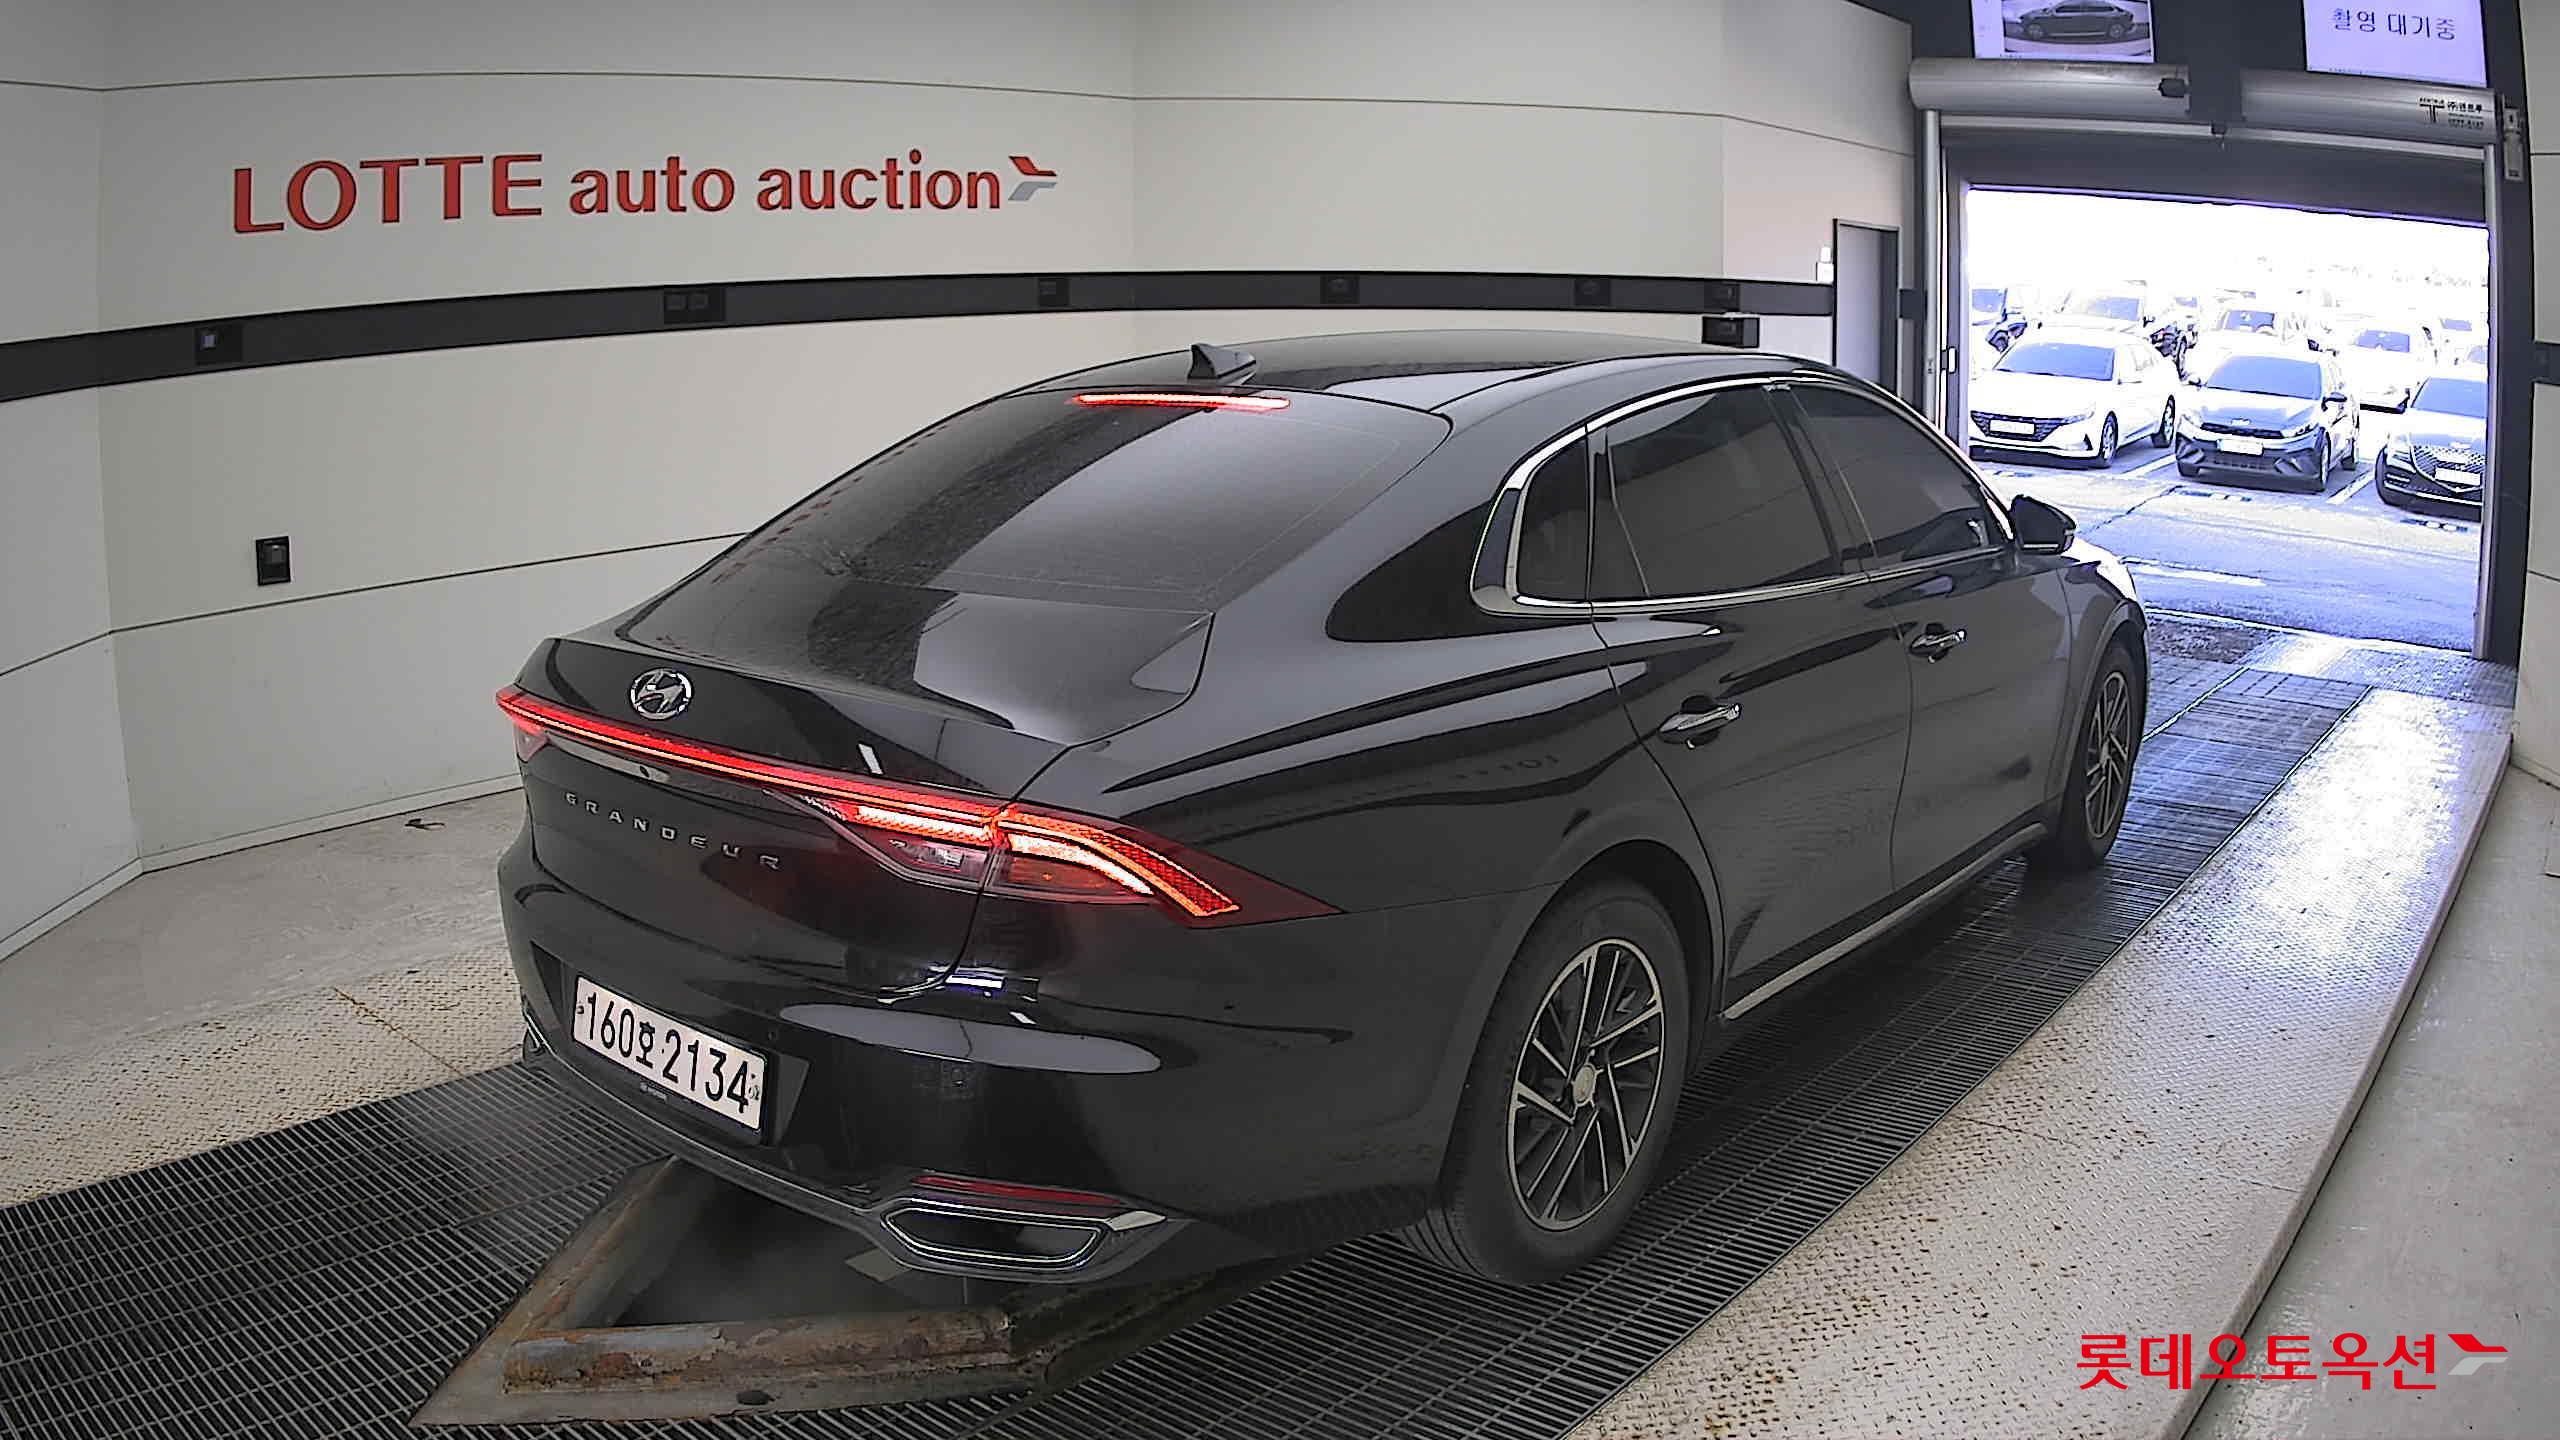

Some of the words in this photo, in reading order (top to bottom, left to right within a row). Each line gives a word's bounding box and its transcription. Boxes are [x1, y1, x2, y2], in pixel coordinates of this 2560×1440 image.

[2333, 7, 2376, 33] 촬영
[2387, 13, 2455, 41] 대기중
[233, 153, 543, 234] LOTTE
[568, 156, 735, 215] auto
[756, 148, 1001, 211] auction
[564, 791, 782, 871] GRANDEUR
[587, 991, 656, 1069] 160호
[661, 1028, 749, 1114] 2134
